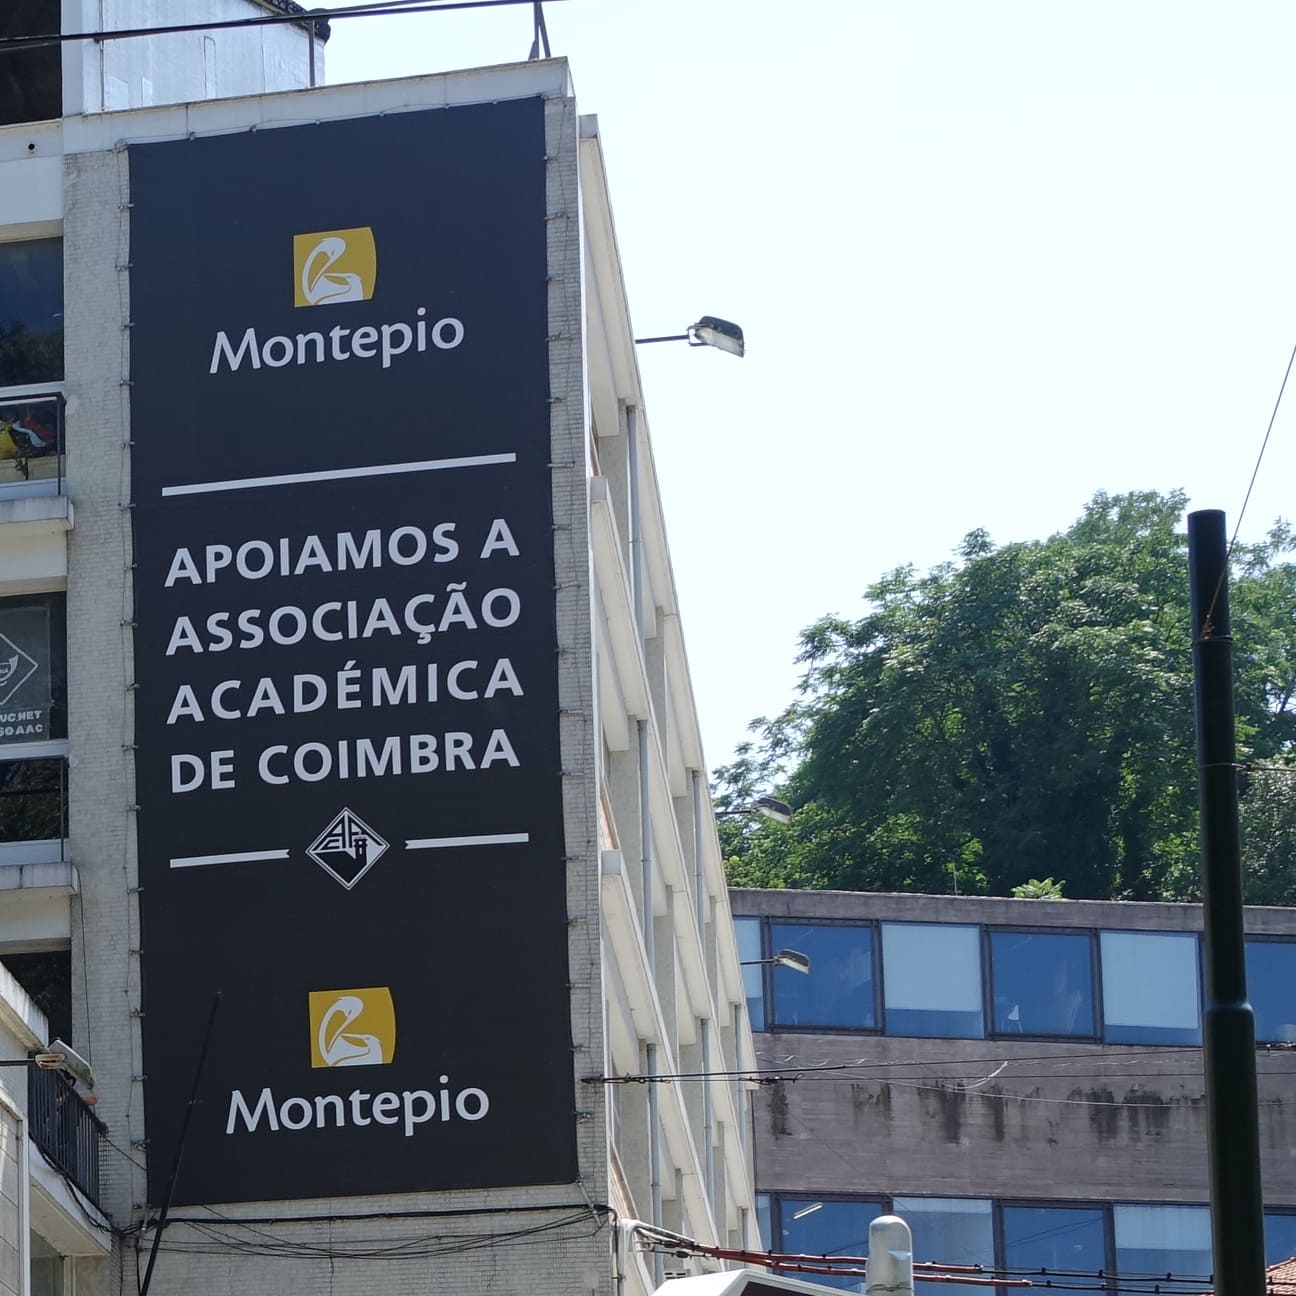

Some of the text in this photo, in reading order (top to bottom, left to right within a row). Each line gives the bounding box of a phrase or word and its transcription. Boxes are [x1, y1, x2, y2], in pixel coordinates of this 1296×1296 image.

[209, 307, 465, 374] Montepio
[164, 518, 521, 588] APOIAMOS A
[165, 581, 521, 656] ASSOCIAÇÃO
[166, 658, 524, 725] ACADÉMICA
[170, 729, 521, 793] DE COIMBRA
[226, 1075, 490, 1136] Montepio
